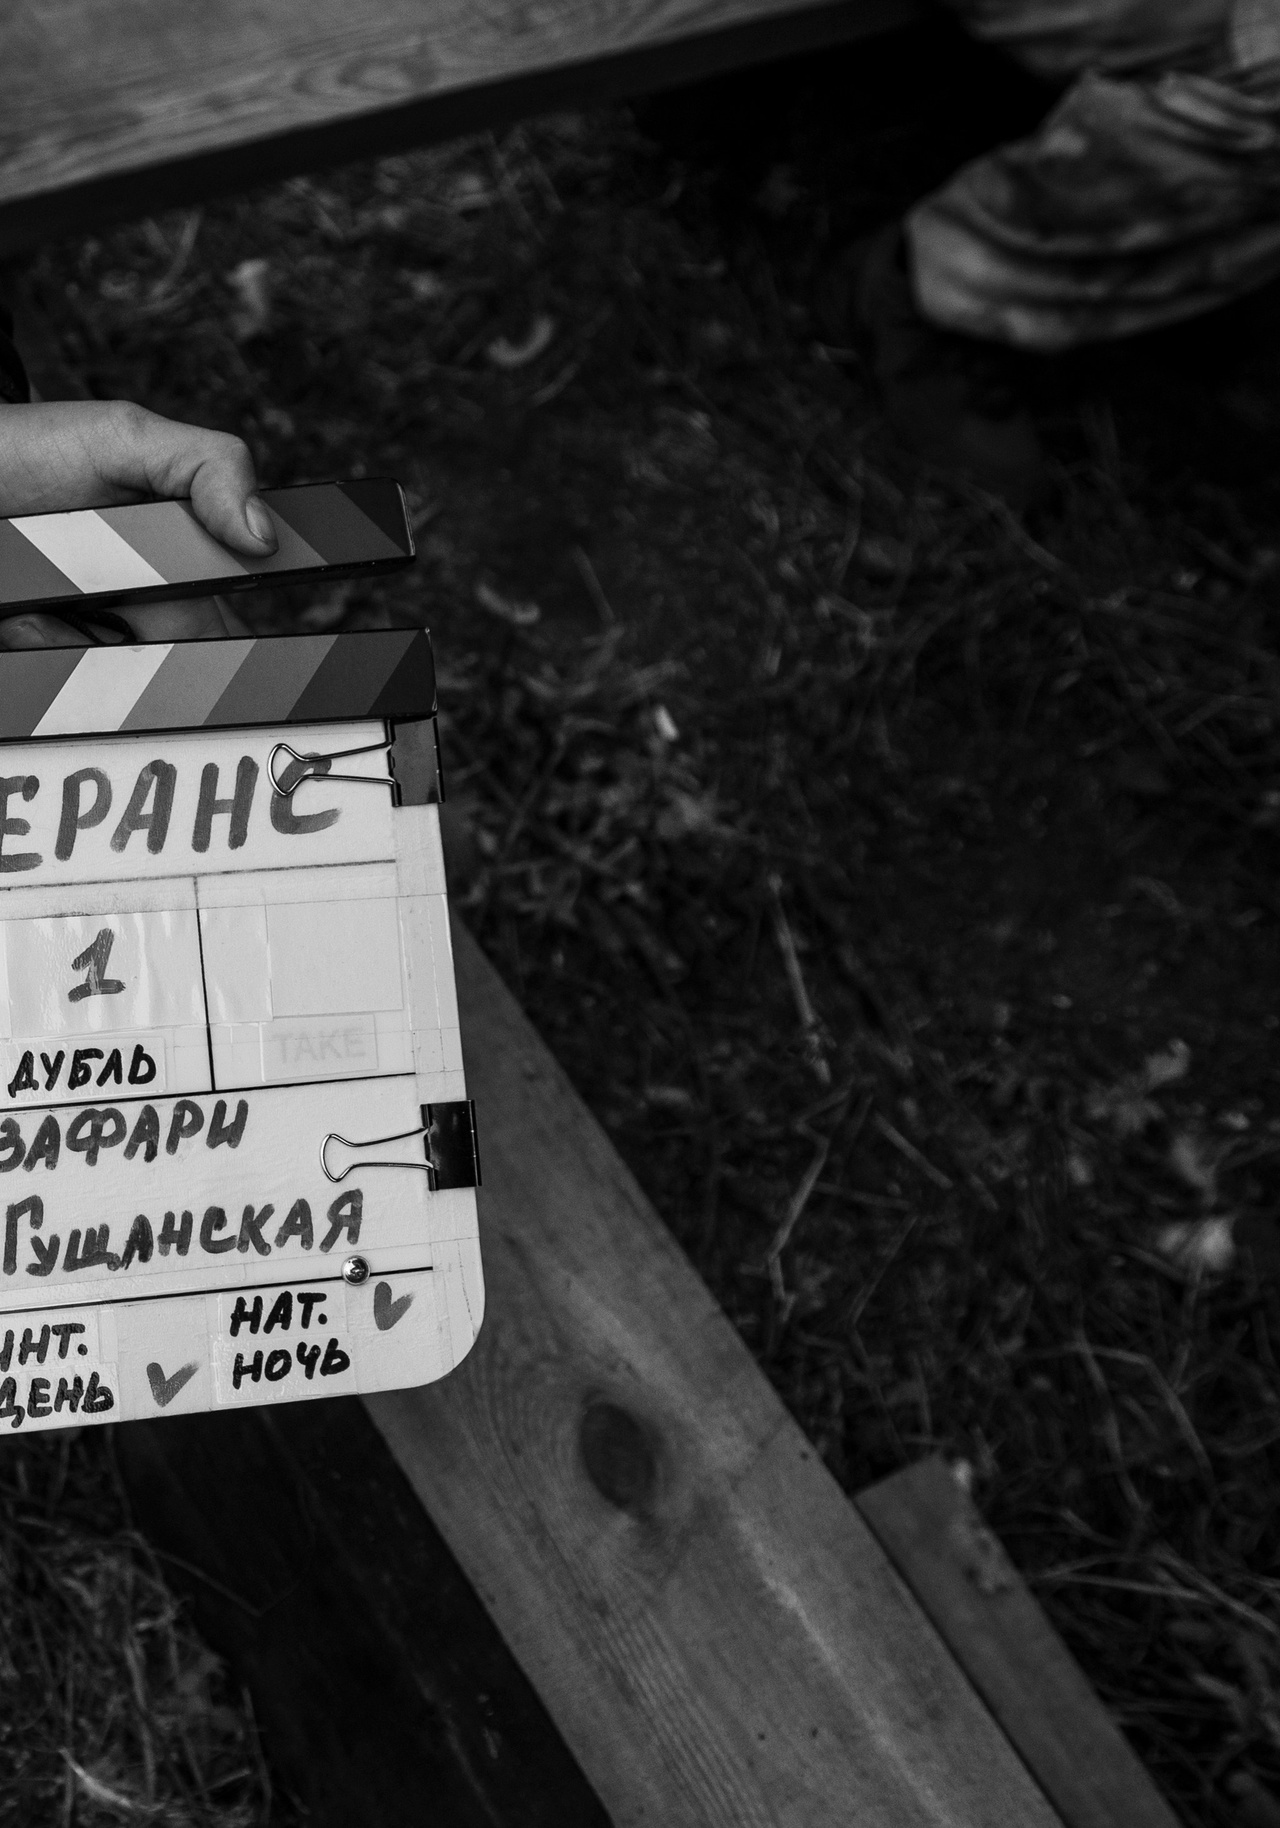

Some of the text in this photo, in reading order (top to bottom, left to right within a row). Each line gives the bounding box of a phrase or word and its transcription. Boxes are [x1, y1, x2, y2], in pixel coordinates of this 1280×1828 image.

[68, 928, 126, 1003] 1
[8, 1044, 157, 1097] ДУБЛЬ
[271, 1027, 366, 1064] TAKE
[230, 1291, 328, 1336] НАТ.
[232, 1338, 351, 1388] НОЧЬ
